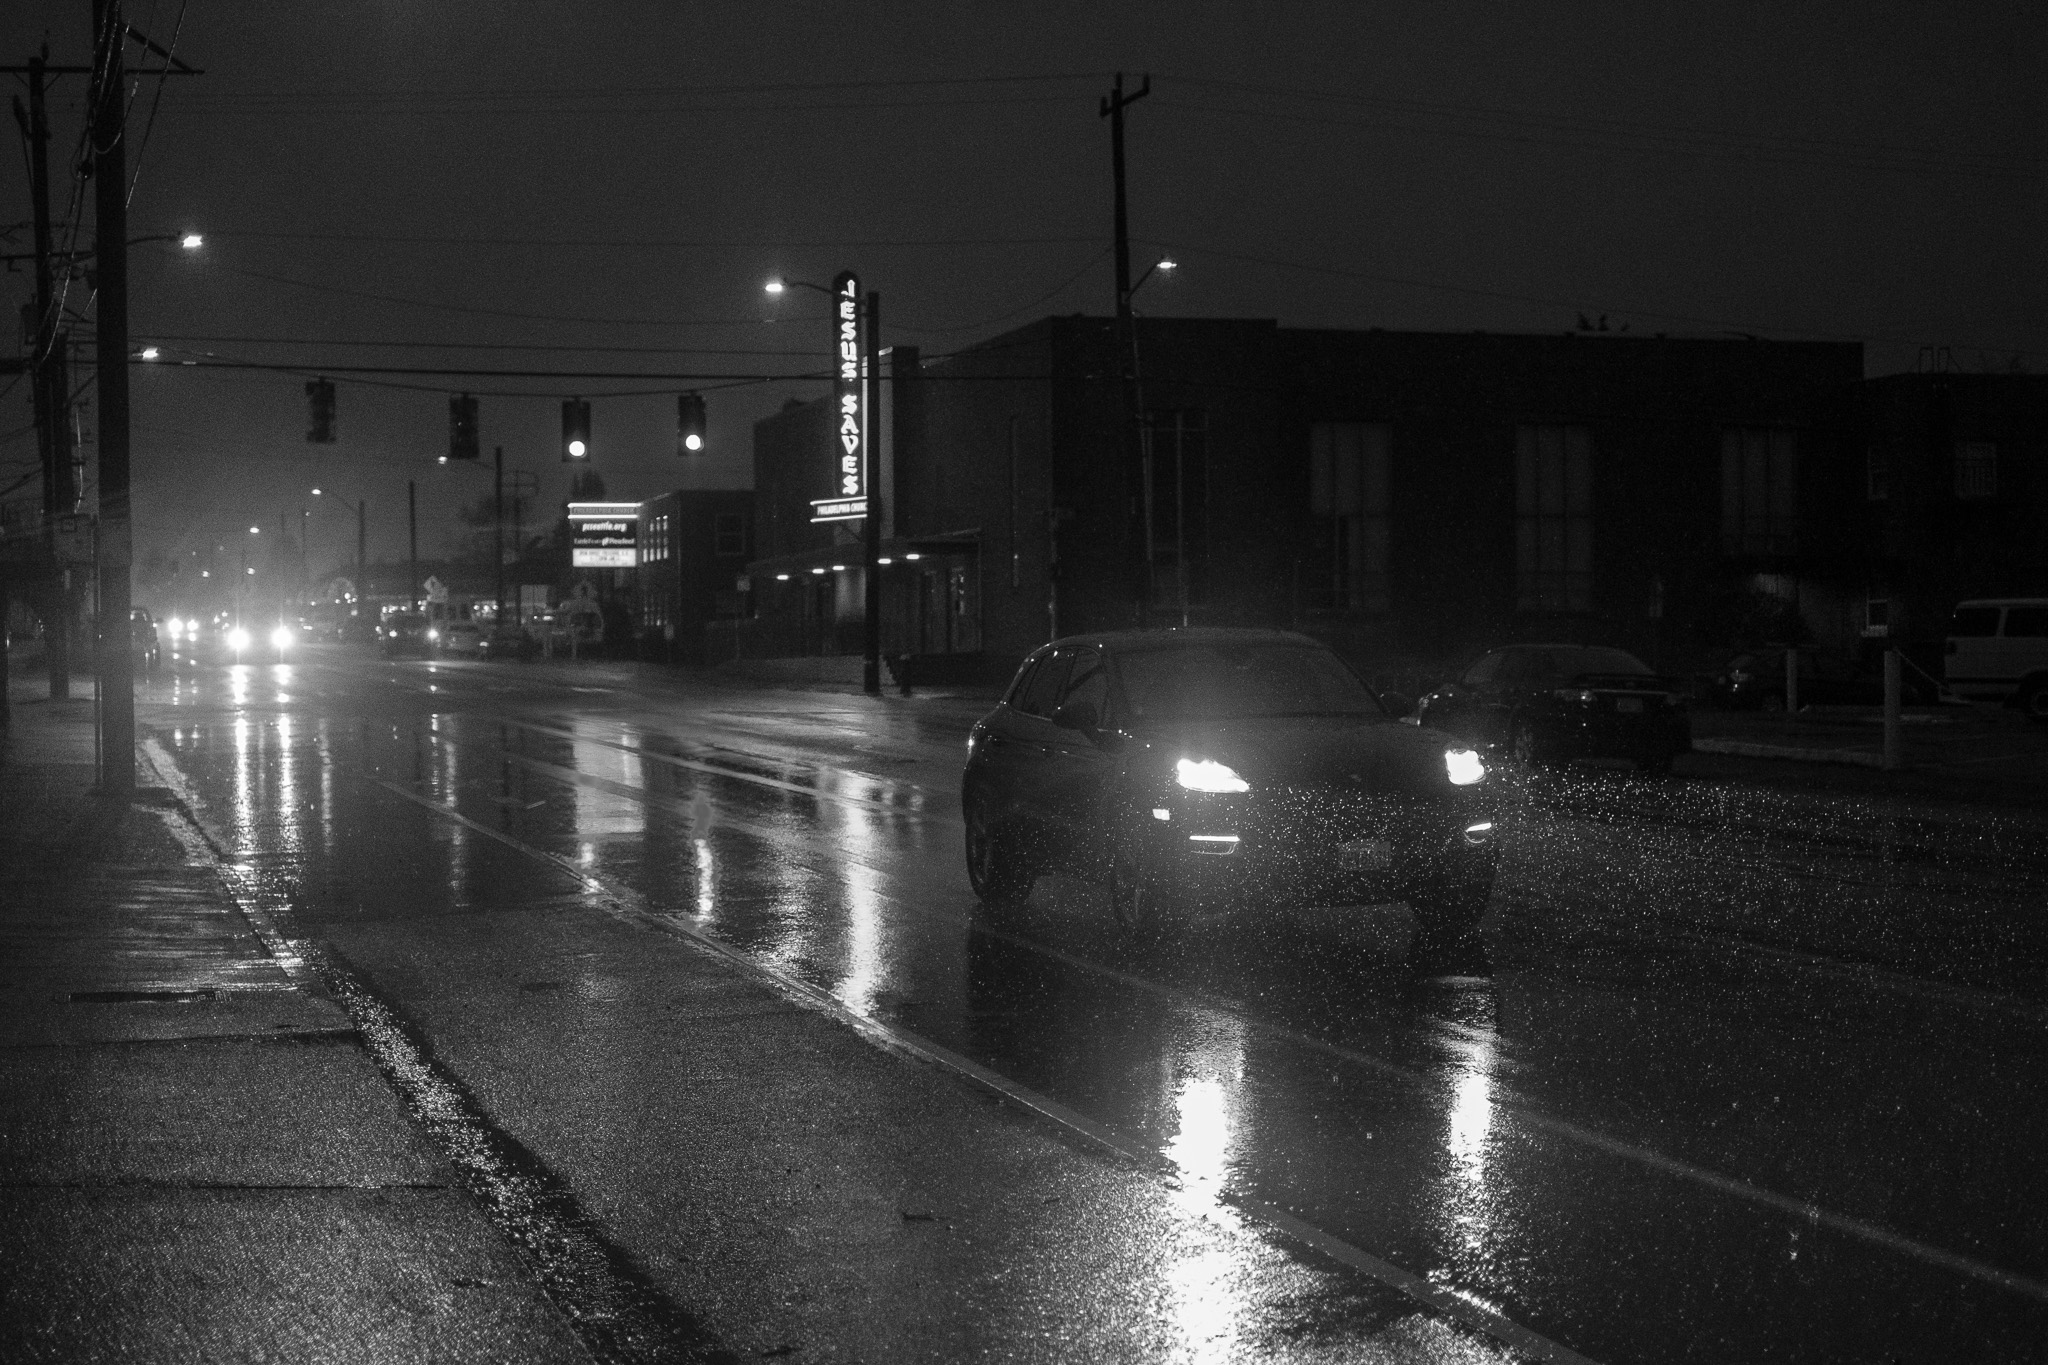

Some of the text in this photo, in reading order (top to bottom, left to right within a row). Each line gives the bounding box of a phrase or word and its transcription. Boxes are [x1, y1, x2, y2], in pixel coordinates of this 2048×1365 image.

[840, 279, 860, 495] JESUS SAVES
[850, 501, 867, 513] CHURC
